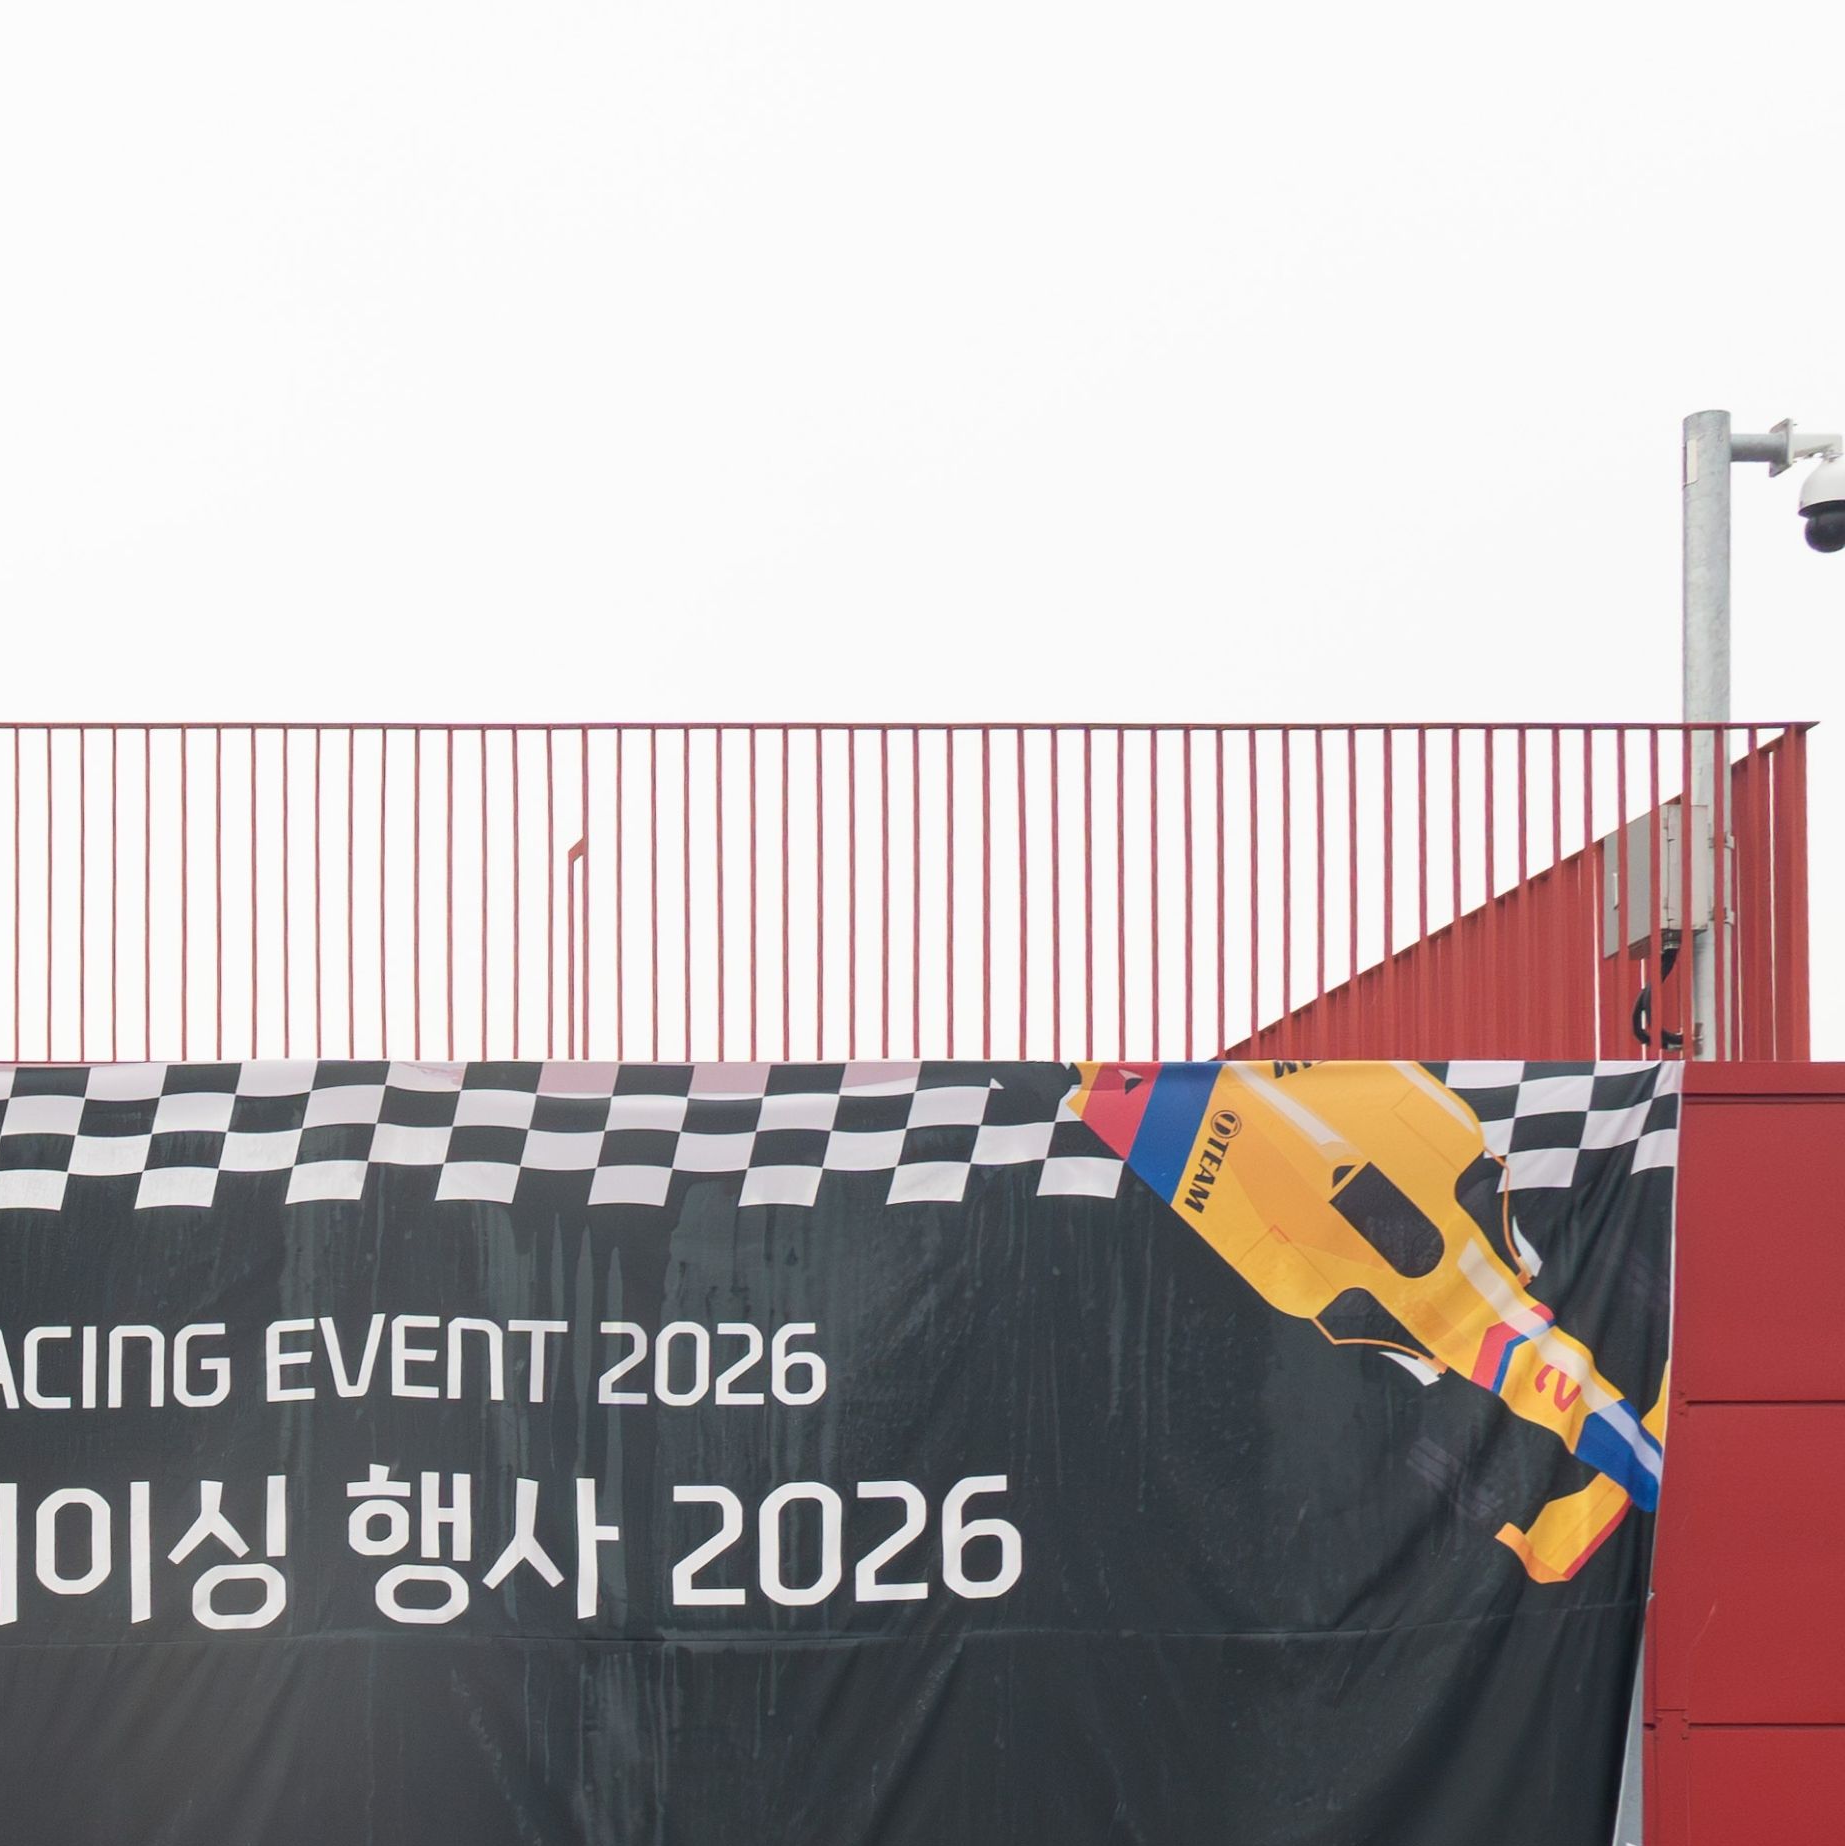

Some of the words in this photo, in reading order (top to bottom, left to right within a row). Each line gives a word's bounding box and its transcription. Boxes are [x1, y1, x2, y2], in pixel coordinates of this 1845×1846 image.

[1183, 1137, 1233, 1215] TEAM
[266, 1314, 568, 1402] EVENT
[598, 1321, 826, 1406] 2026
[347, 1464, 619, 1624] 행사
[672, 1475, 1022, 1605] 2026
